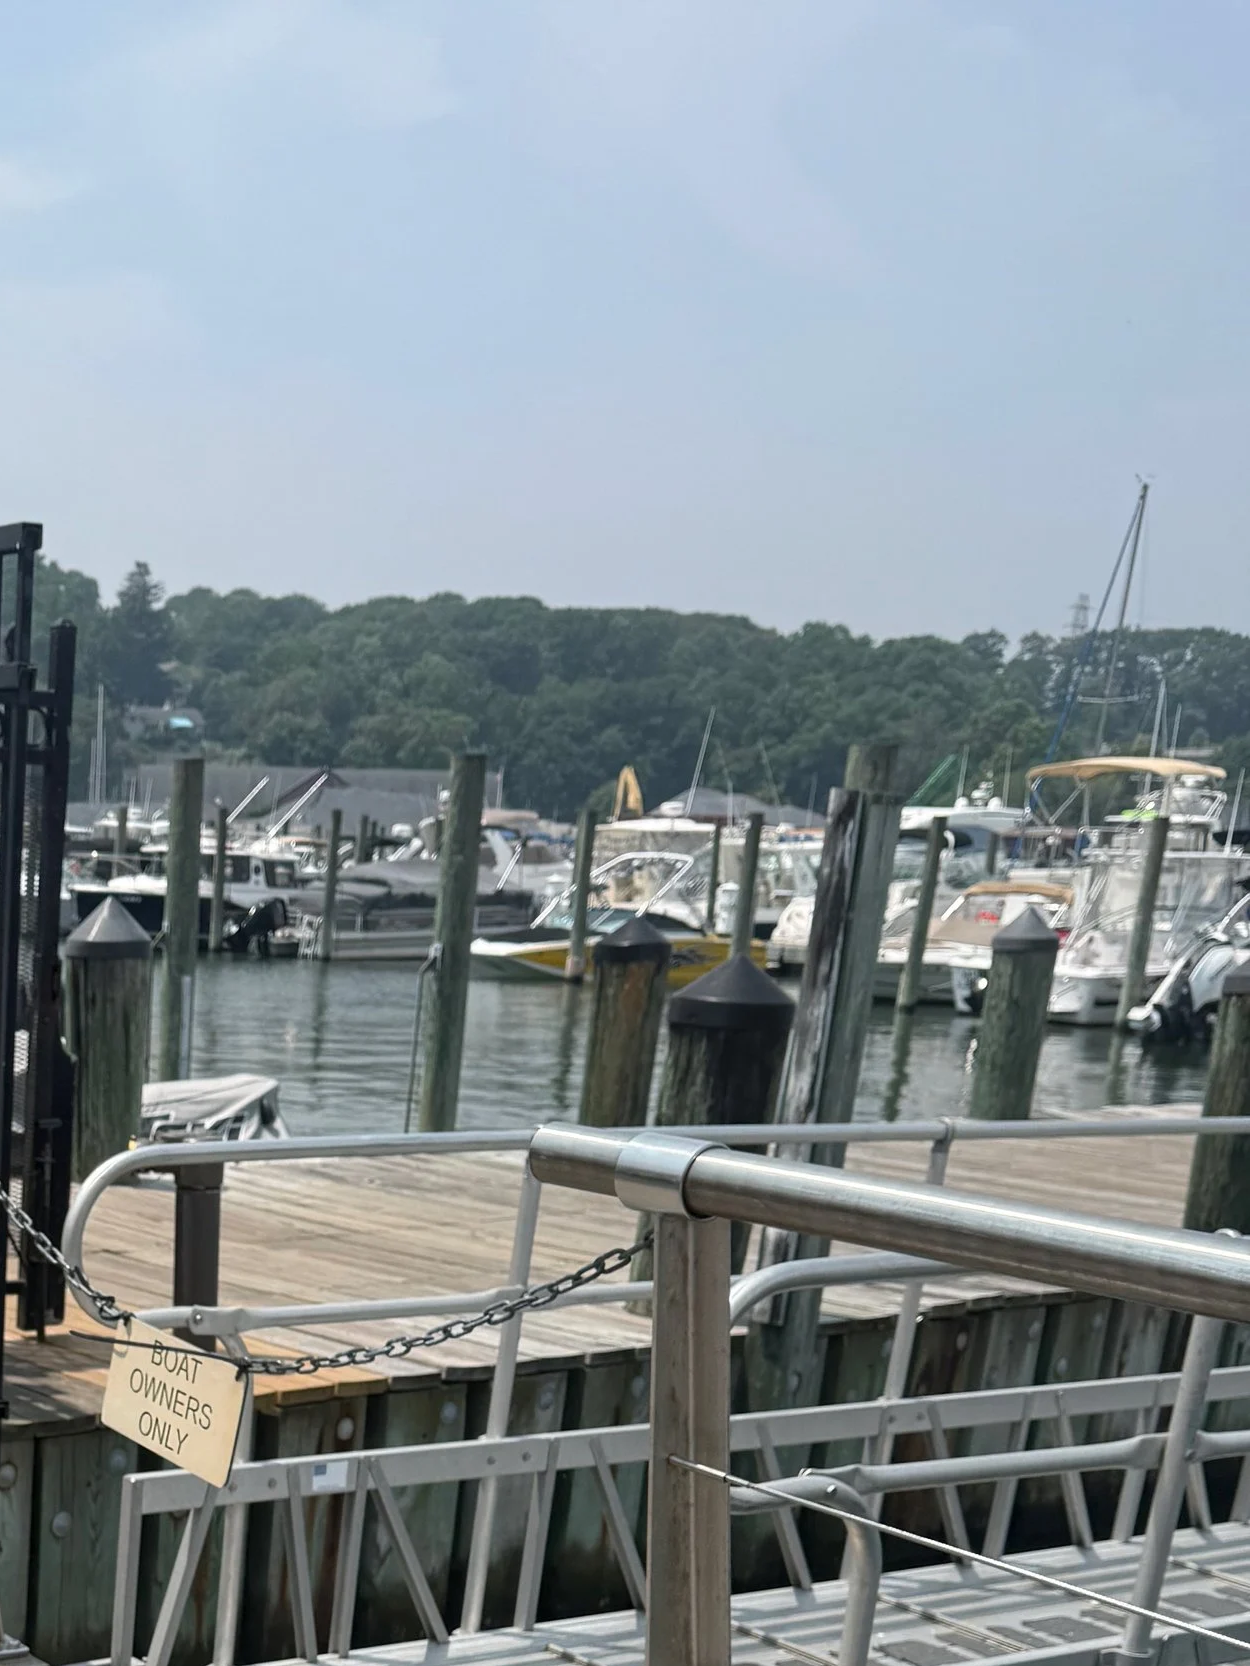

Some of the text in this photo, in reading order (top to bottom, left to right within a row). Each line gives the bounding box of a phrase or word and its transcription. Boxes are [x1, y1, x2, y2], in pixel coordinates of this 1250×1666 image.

[151, 1340, 203, 1384] BOAT
[129, 1368, 213, 1430] OWNERS
[138, 1411, 189, 1455] ONLY
